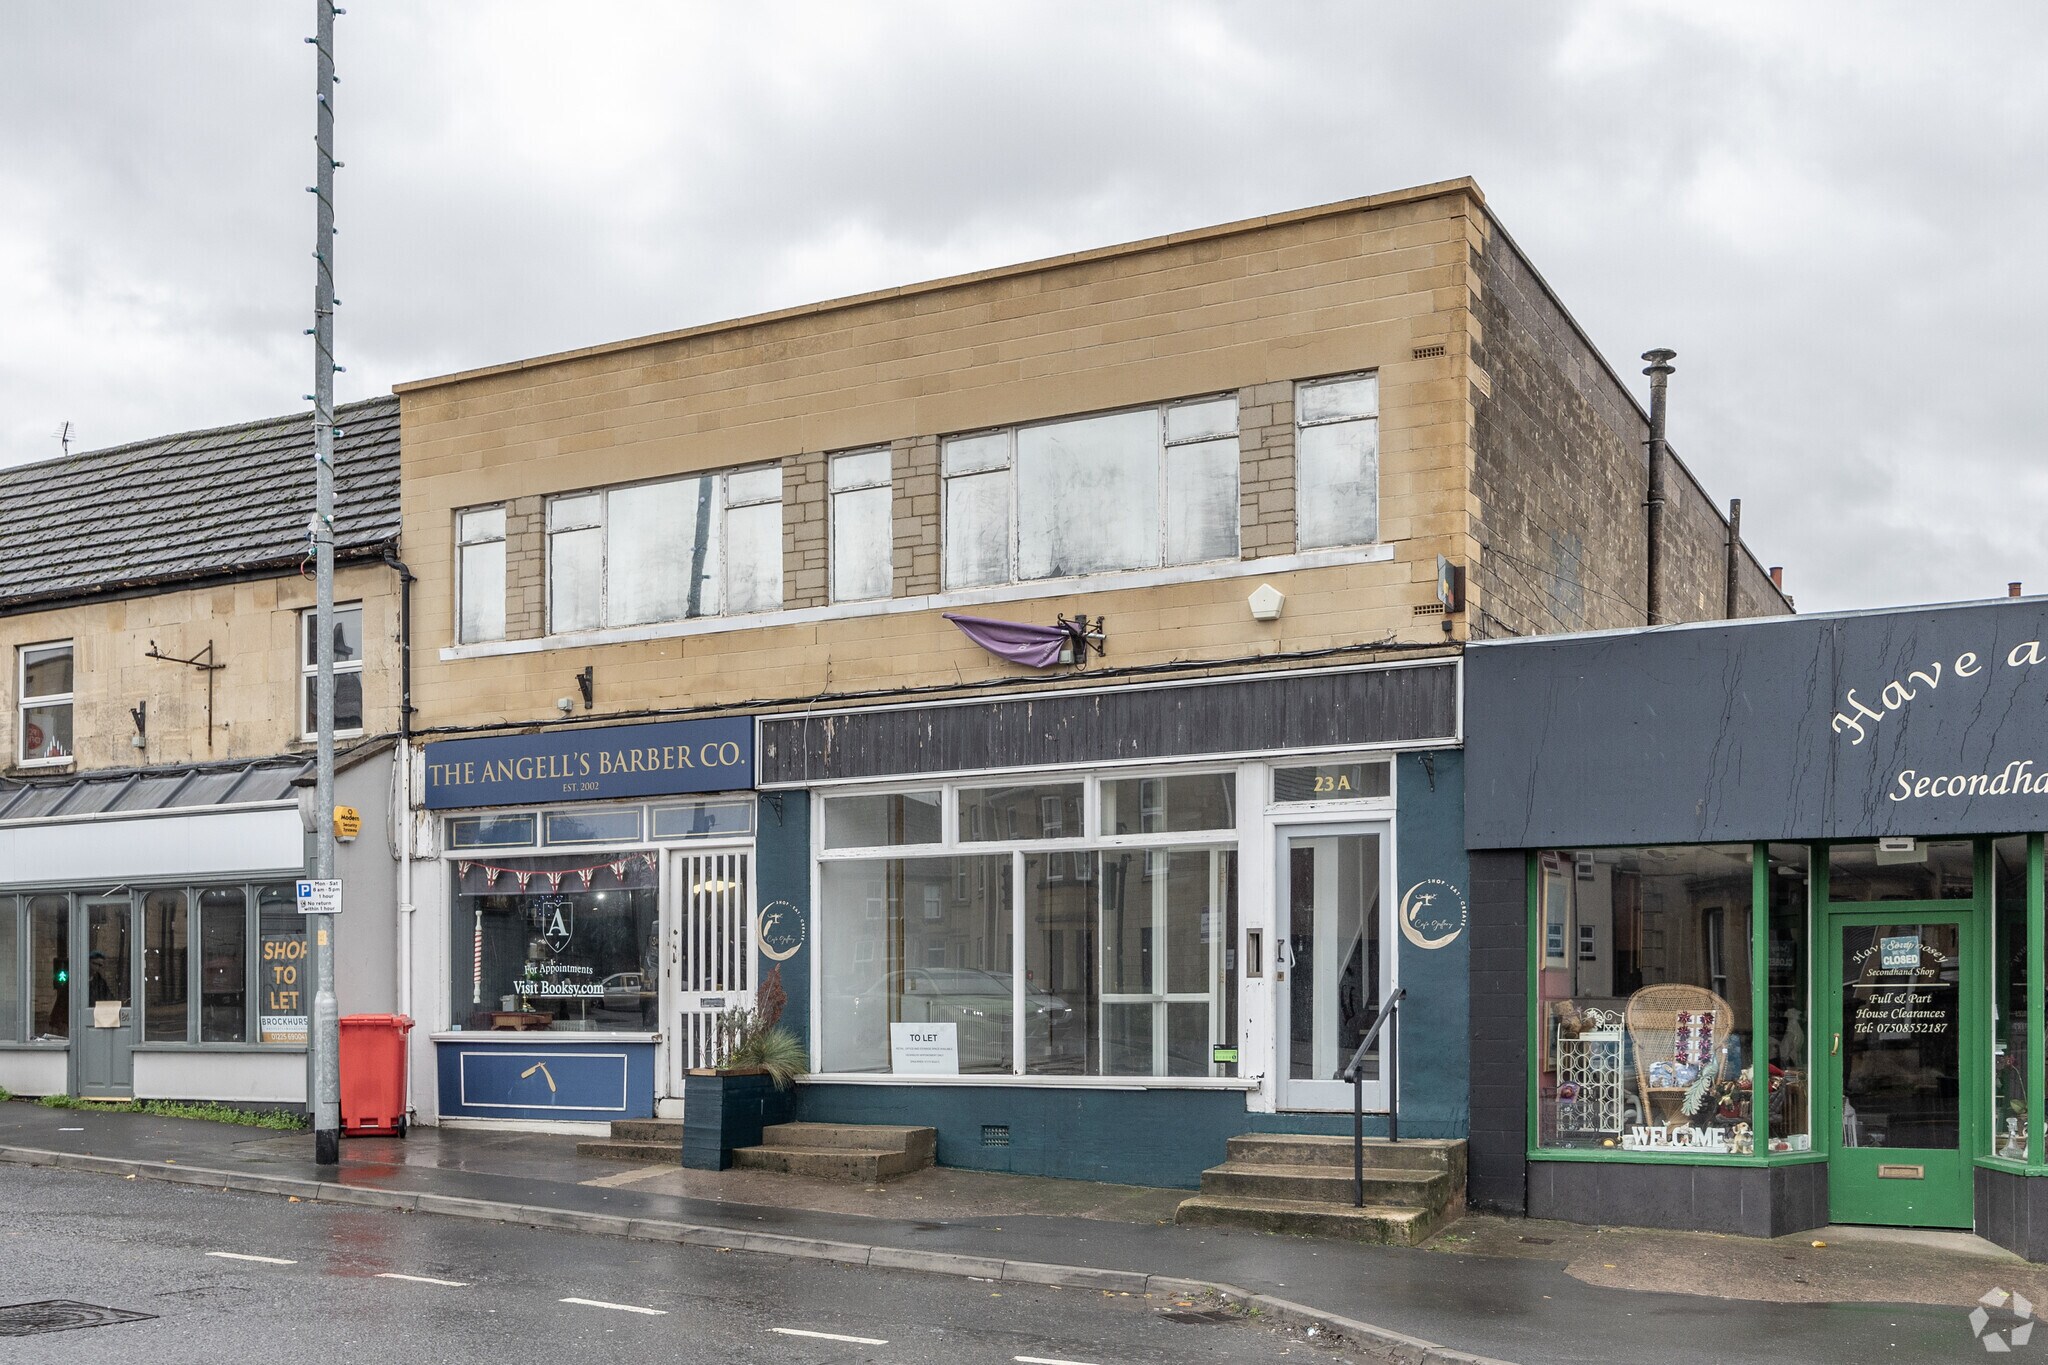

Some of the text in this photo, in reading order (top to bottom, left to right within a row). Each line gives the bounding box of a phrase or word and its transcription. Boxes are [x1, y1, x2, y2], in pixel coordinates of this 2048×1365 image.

[1831, 641, 2047, 746] Have a
[429, 741, 746, 787] THE ANGELL'S BARBER CO.
[562, 782, 599, 792] EST. 2002
[1889, 760, 2048, 802] Secondha
[1450, 886, 1460, 896] EAT
[546, 908, 569, 936] A
[1884, 955, 1918, 965] CLOSED
[274, 966, 296, 985] TO
[524, 963, 593, 975] For Appointments
[1867, 967, 1935, 977] Secondhand Shop
[513, 980, 604, 997] Visit Booksy.com
[270, 992, 299, 1010] LET
[1870, 993, 1932, 1004] Full & Part
[1856, 1008, 1945, 1019] House Clearances
[1855, 1022, 1948, 1033] Tel: 07508552187
[1632, 1126, 1725, 1147] WELCOME
